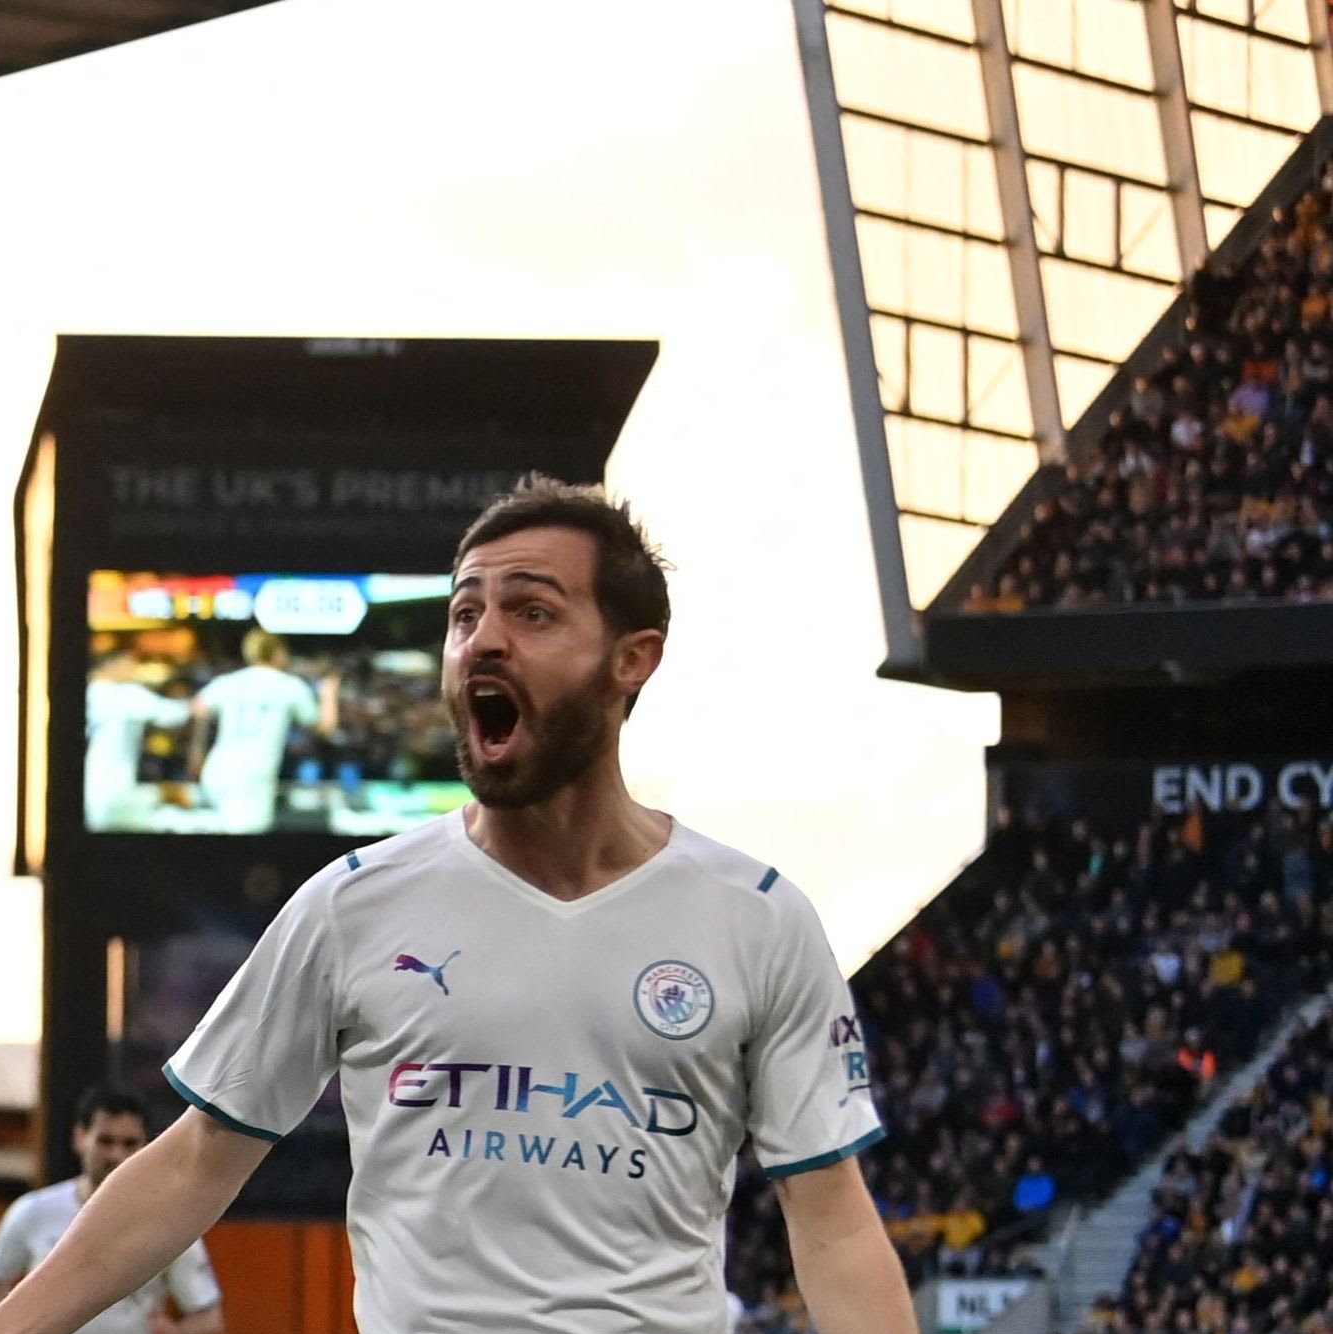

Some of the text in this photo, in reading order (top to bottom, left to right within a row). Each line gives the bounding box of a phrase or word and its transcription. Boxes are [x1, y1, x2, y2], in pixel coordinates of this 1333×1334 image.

[113, 464, 197, 505] THE
[1152, 762, 1263, 814] END
[388, 1062, 698, 1137] ETIHAD
[426, 1127, 647, 1180] AIRWAYS
